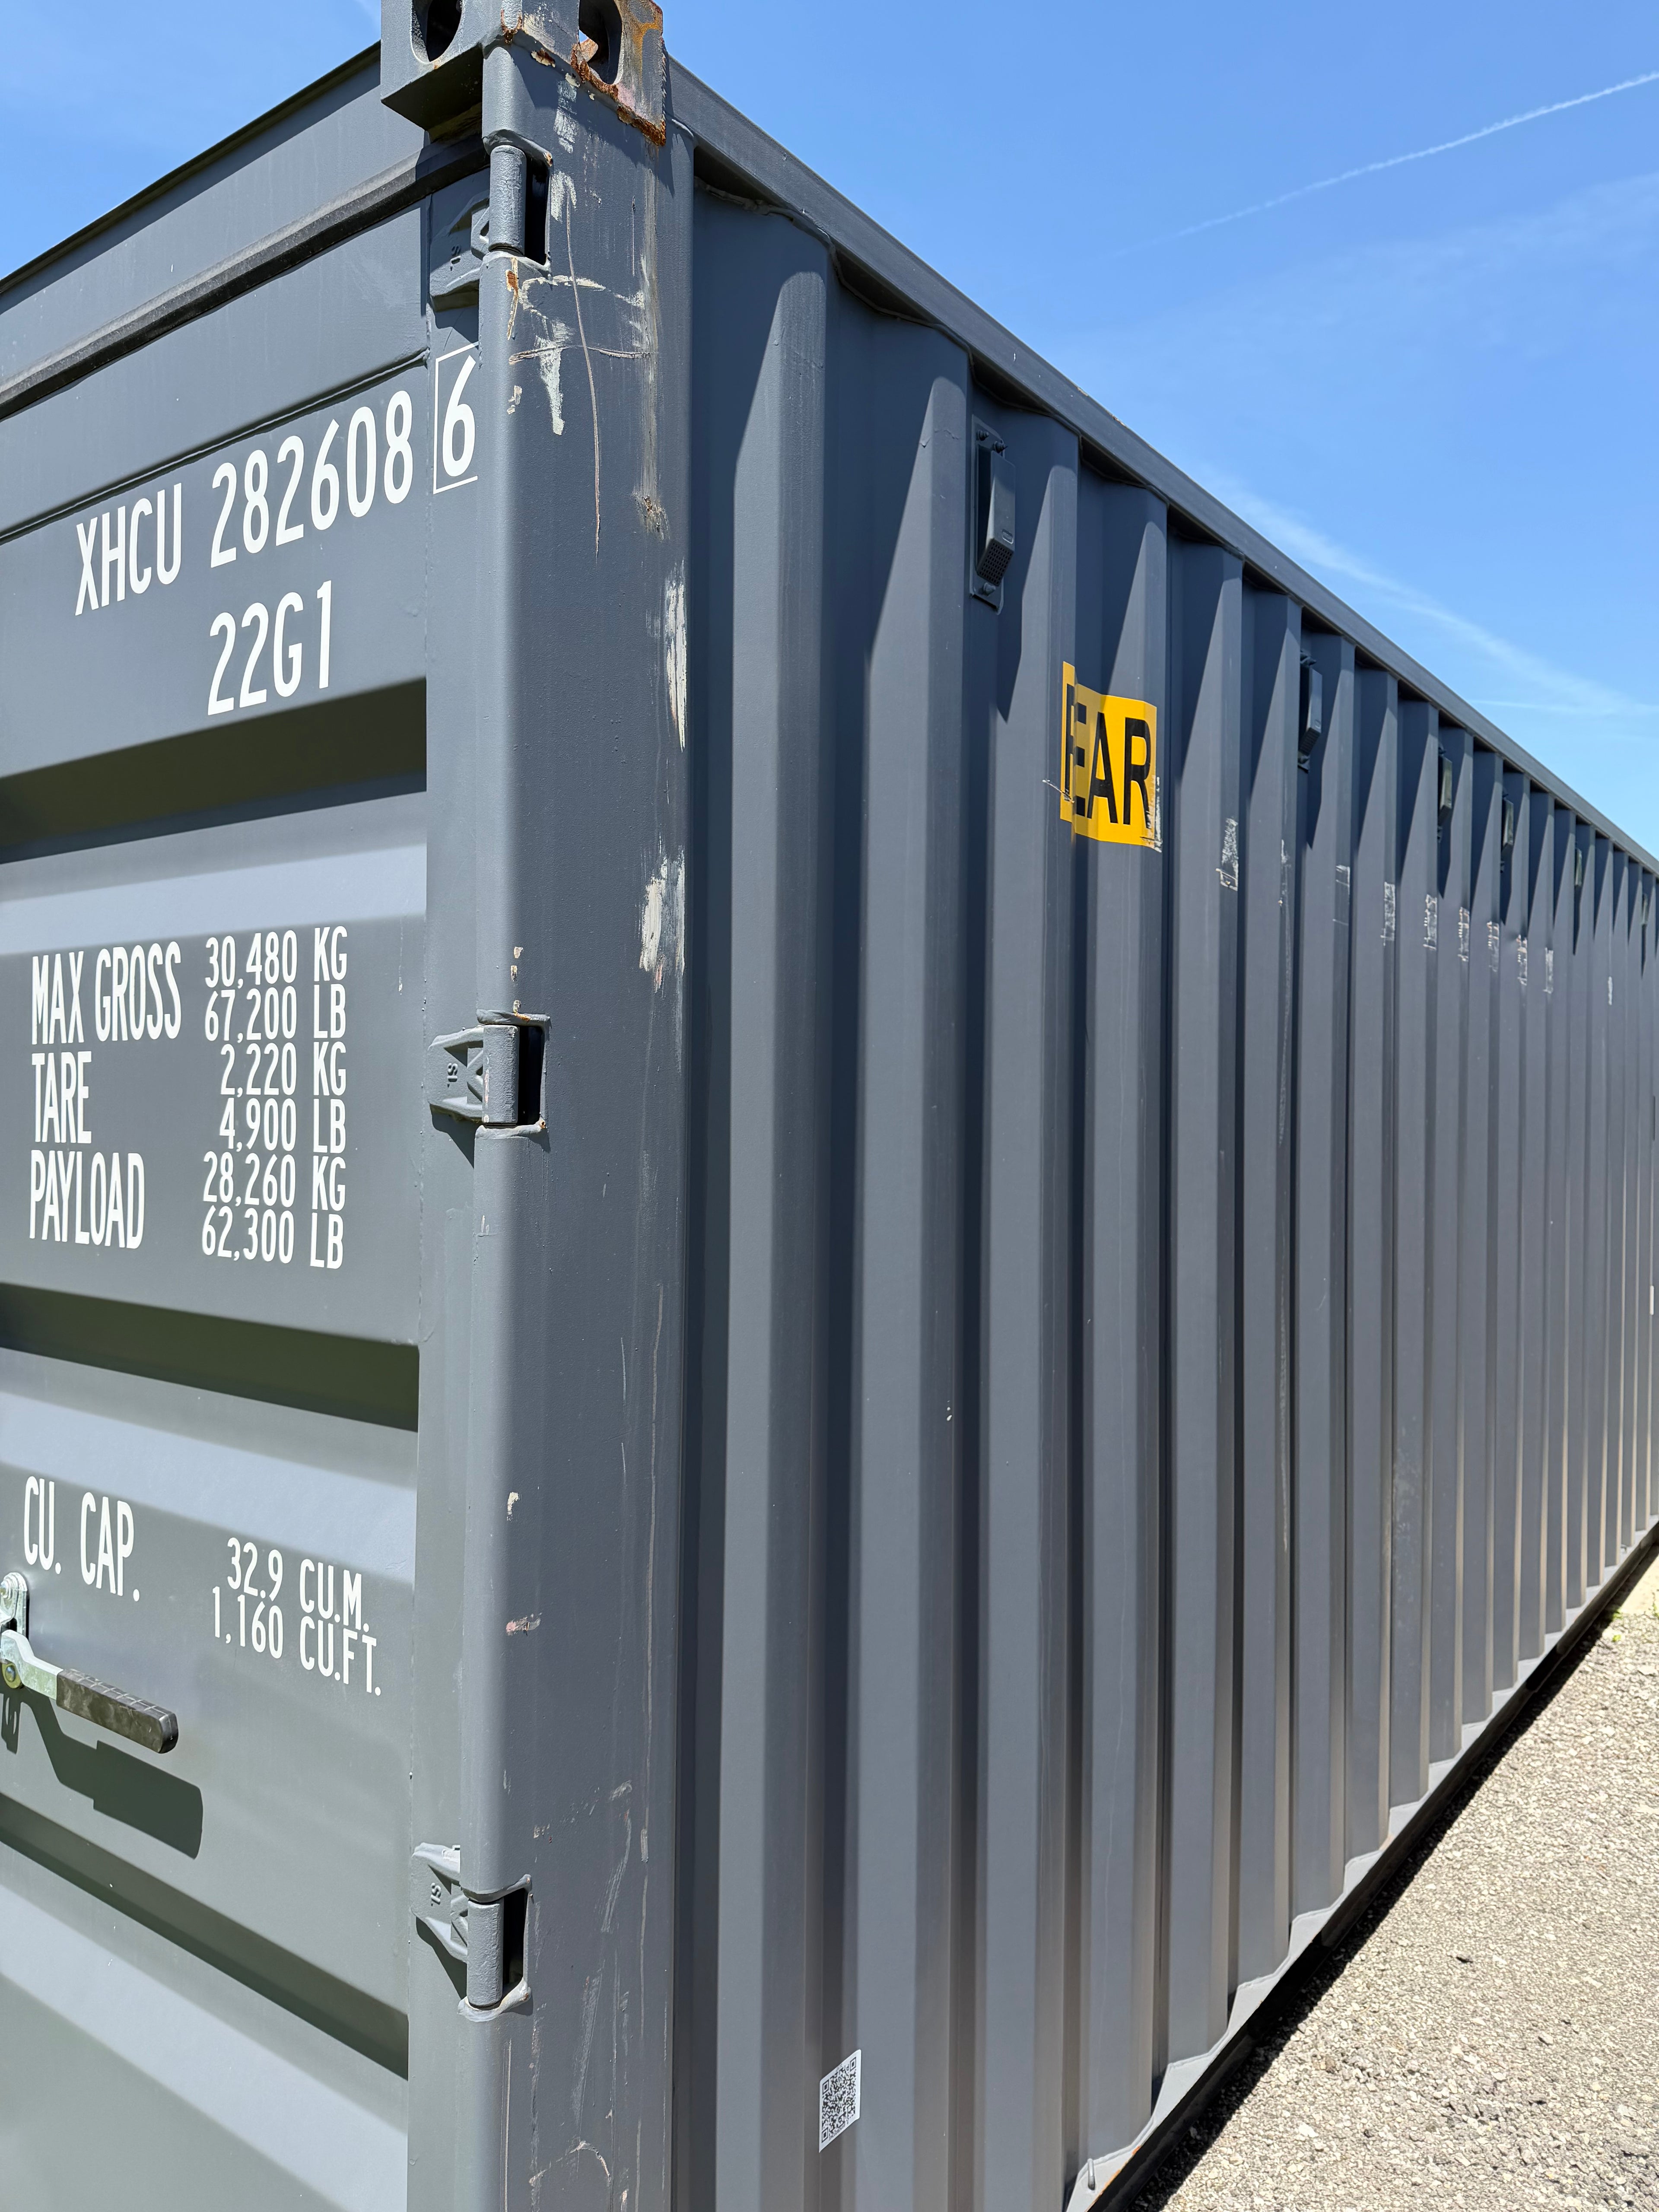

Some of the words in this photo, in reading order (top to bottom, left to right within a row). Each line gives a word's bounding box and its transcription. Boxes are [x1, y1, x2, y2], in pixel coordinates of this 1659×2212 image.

[75, 483, 181, 616] XHCU
[210, 390, 413, 568] 282608
[442, 355, 476, 477] 6
[207, 580, 332, 715] 22G1
[32, 951, 84, 1045] MAX
[95, 941, 181, 1042] GROSS
[205, 930, 297, 989] 30,480
[314, 926, 347, 982] KG
[205, 985, 297, 1043] 67,200
[314, 984, 346, 1038] LB
[32, 1051, 92, 1144] TARE
[220, 1042, 297, 1097] 2,220
[314, 1041, 346, 1096] KG
[219, 1097, 296, 1152] 4,900
[313, 1099, 346, 1154] LB
[29, 1150, 144, 1249] PAYLOAD
[203, 1151, 296, 1208] 28,260
[312, 1155, 346, 1211] KG
[202, 1205, 294, 1264] 62,300
[310, 1212, 343, 1269] LB
[24, 1476, 61, 1575] CU.
[80, 1492, 140, 1602] CAP.
[227, 1537, 283, 1601] 32.9
[299, 1559, 369, 1632] CU.M.
[213, 1586, 283, 1659] 1,160
[300, 1616, 381, 1696] CU.FT.
